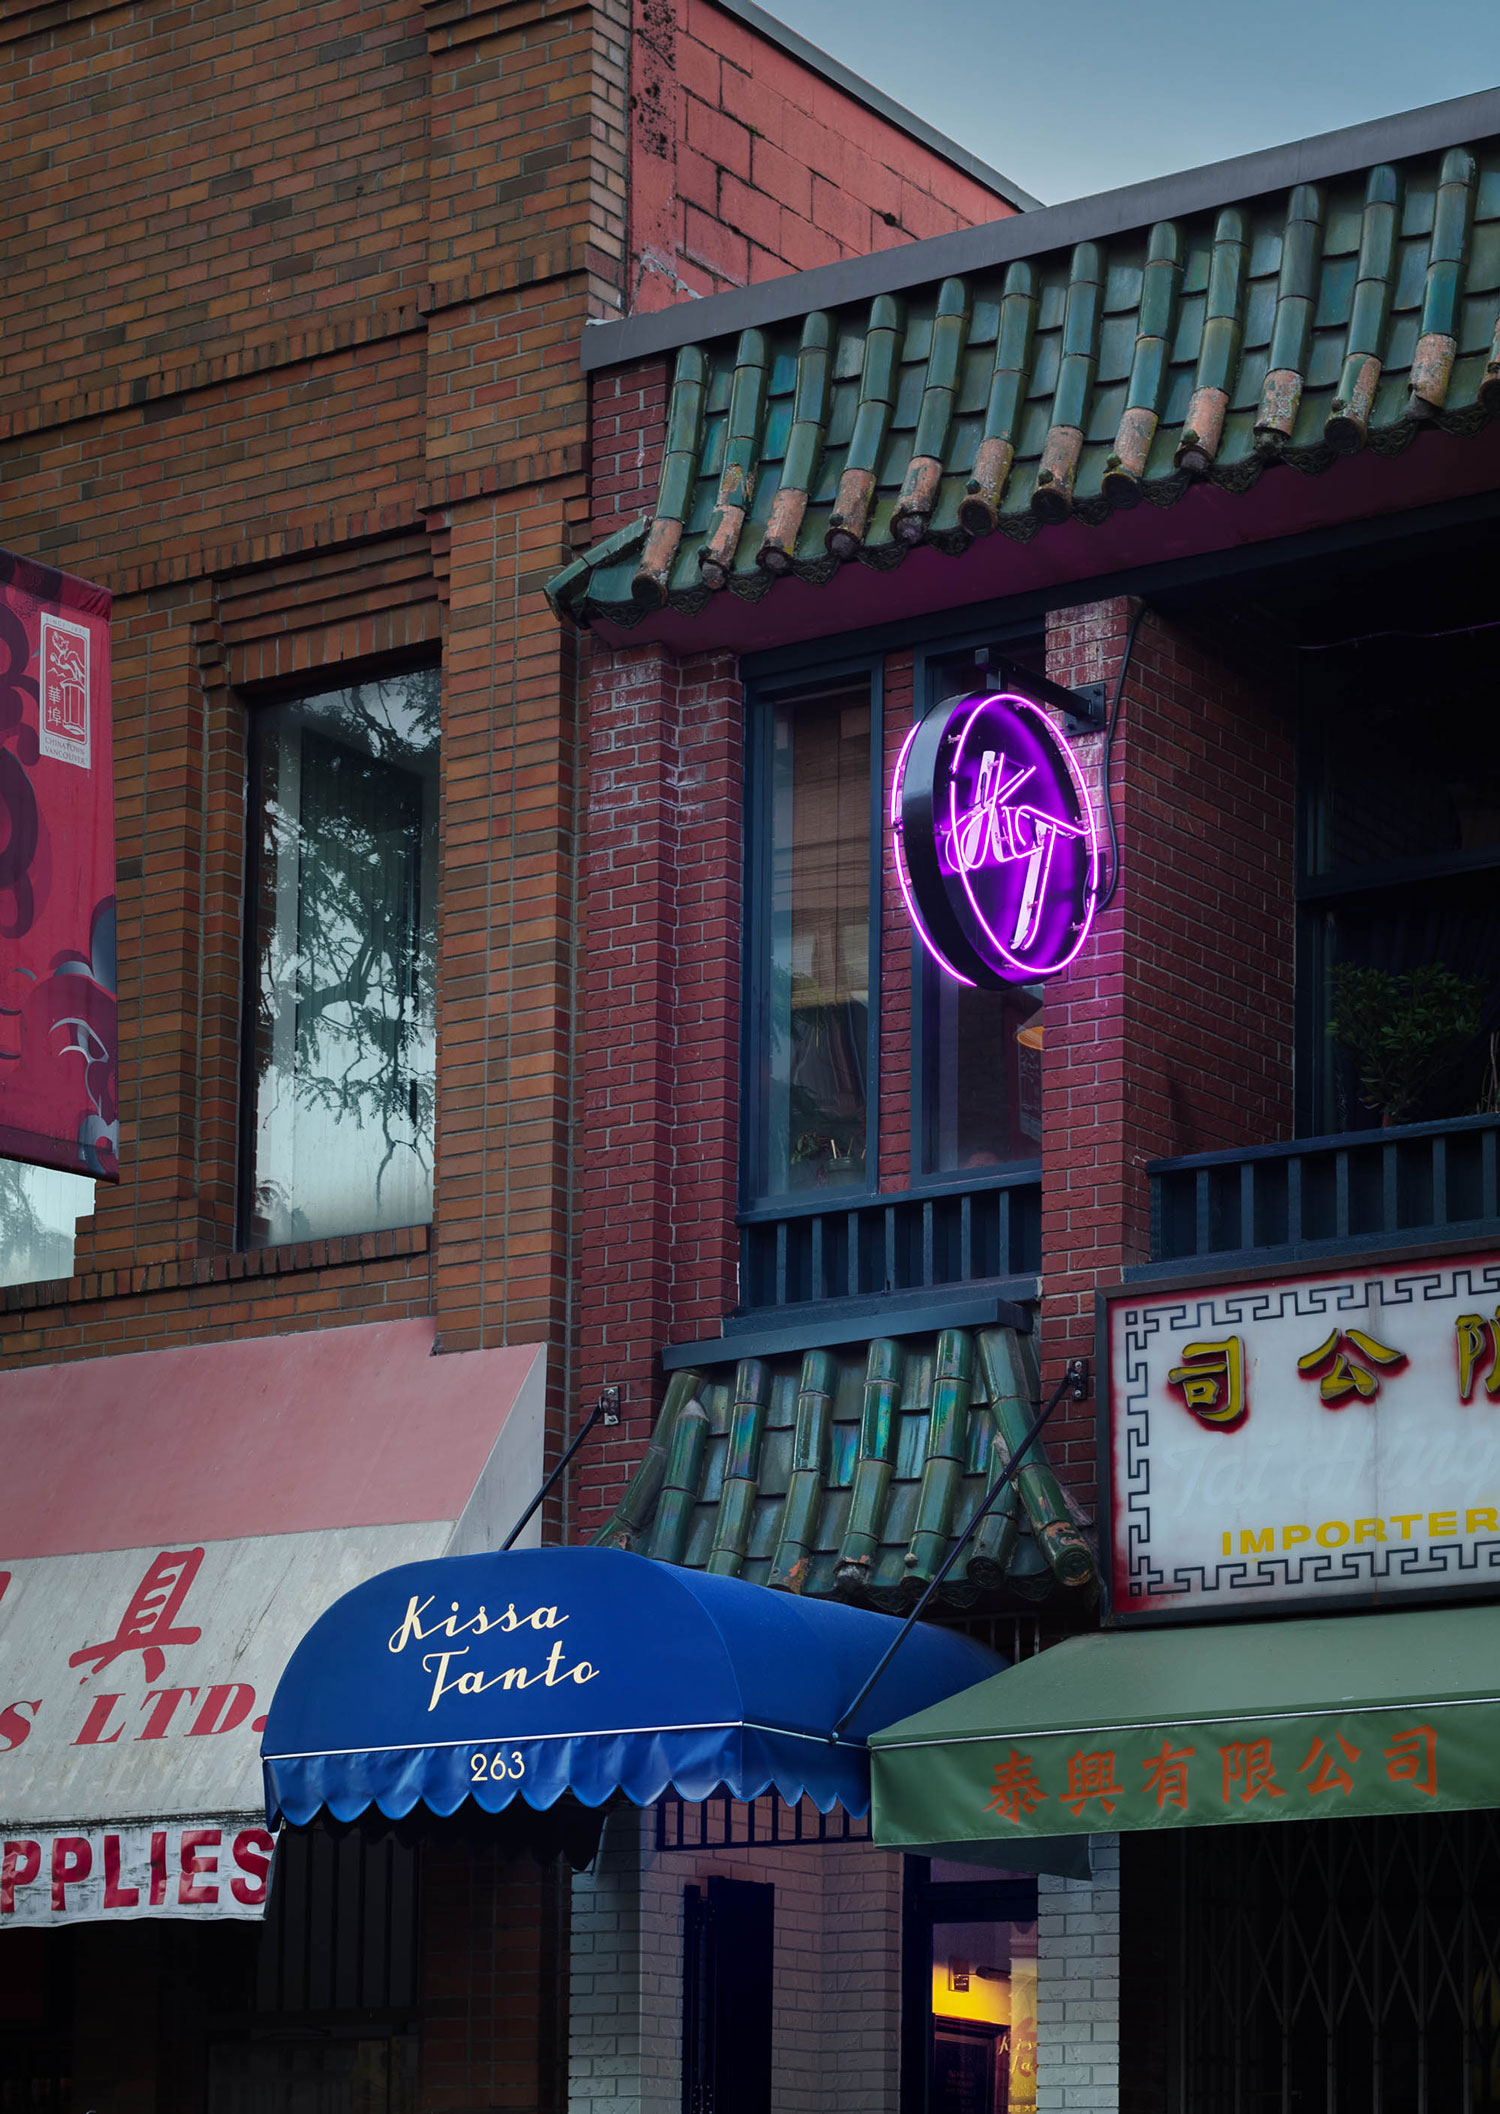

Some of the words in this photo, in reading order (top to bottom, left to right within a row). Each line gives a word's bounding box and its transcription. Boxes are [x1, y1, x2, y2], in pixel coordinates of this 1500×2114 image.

[48, 685, 62, 725] 華埠
[44, 736, 86, 756] CHINATOWN
[44, 744, 87, 765] VANCOUVER
[388, 1595, 570, 1653] Kissa
[422, 1640, 600, 1712] Tanto
[69, 1682, 268, 1746] LTD.
[470, 1751, 526, 1782] 263
[981, 1724, 1438, 1826] 泰興有限公司
